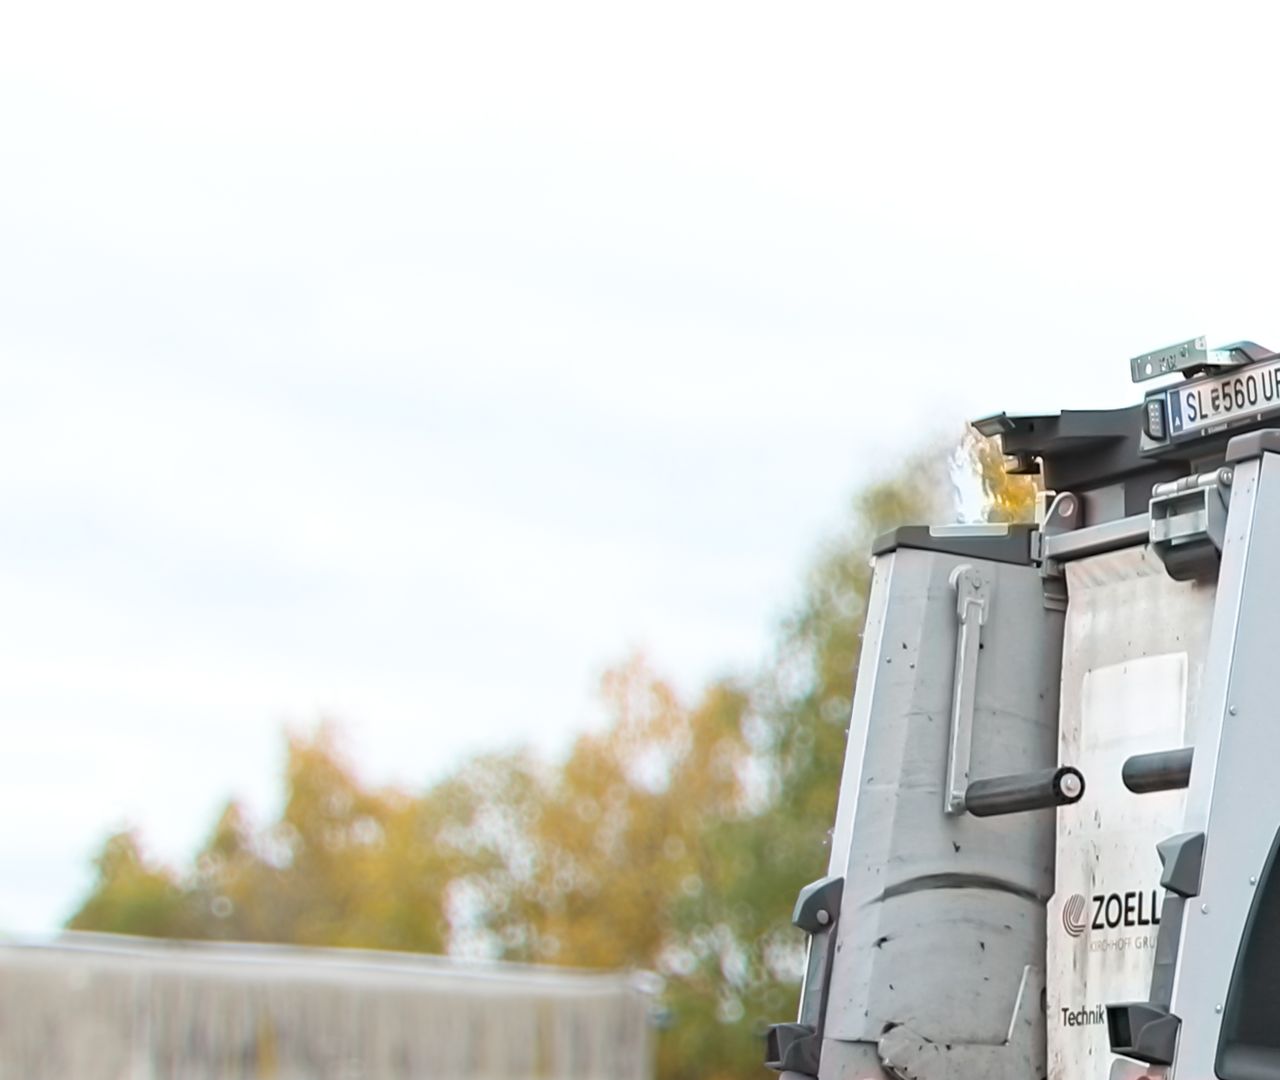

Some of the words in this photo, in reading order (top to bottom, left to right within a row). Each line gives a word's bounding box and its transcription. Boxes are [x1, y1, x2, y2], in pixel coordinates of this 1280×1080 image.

[1186, 390, 1208, 422] SL
[1221, 375, 1258, 412] 560
[1091, 889, 1161, 930] ZOELL
[1061, 1003, 1105, 1027] Technik
